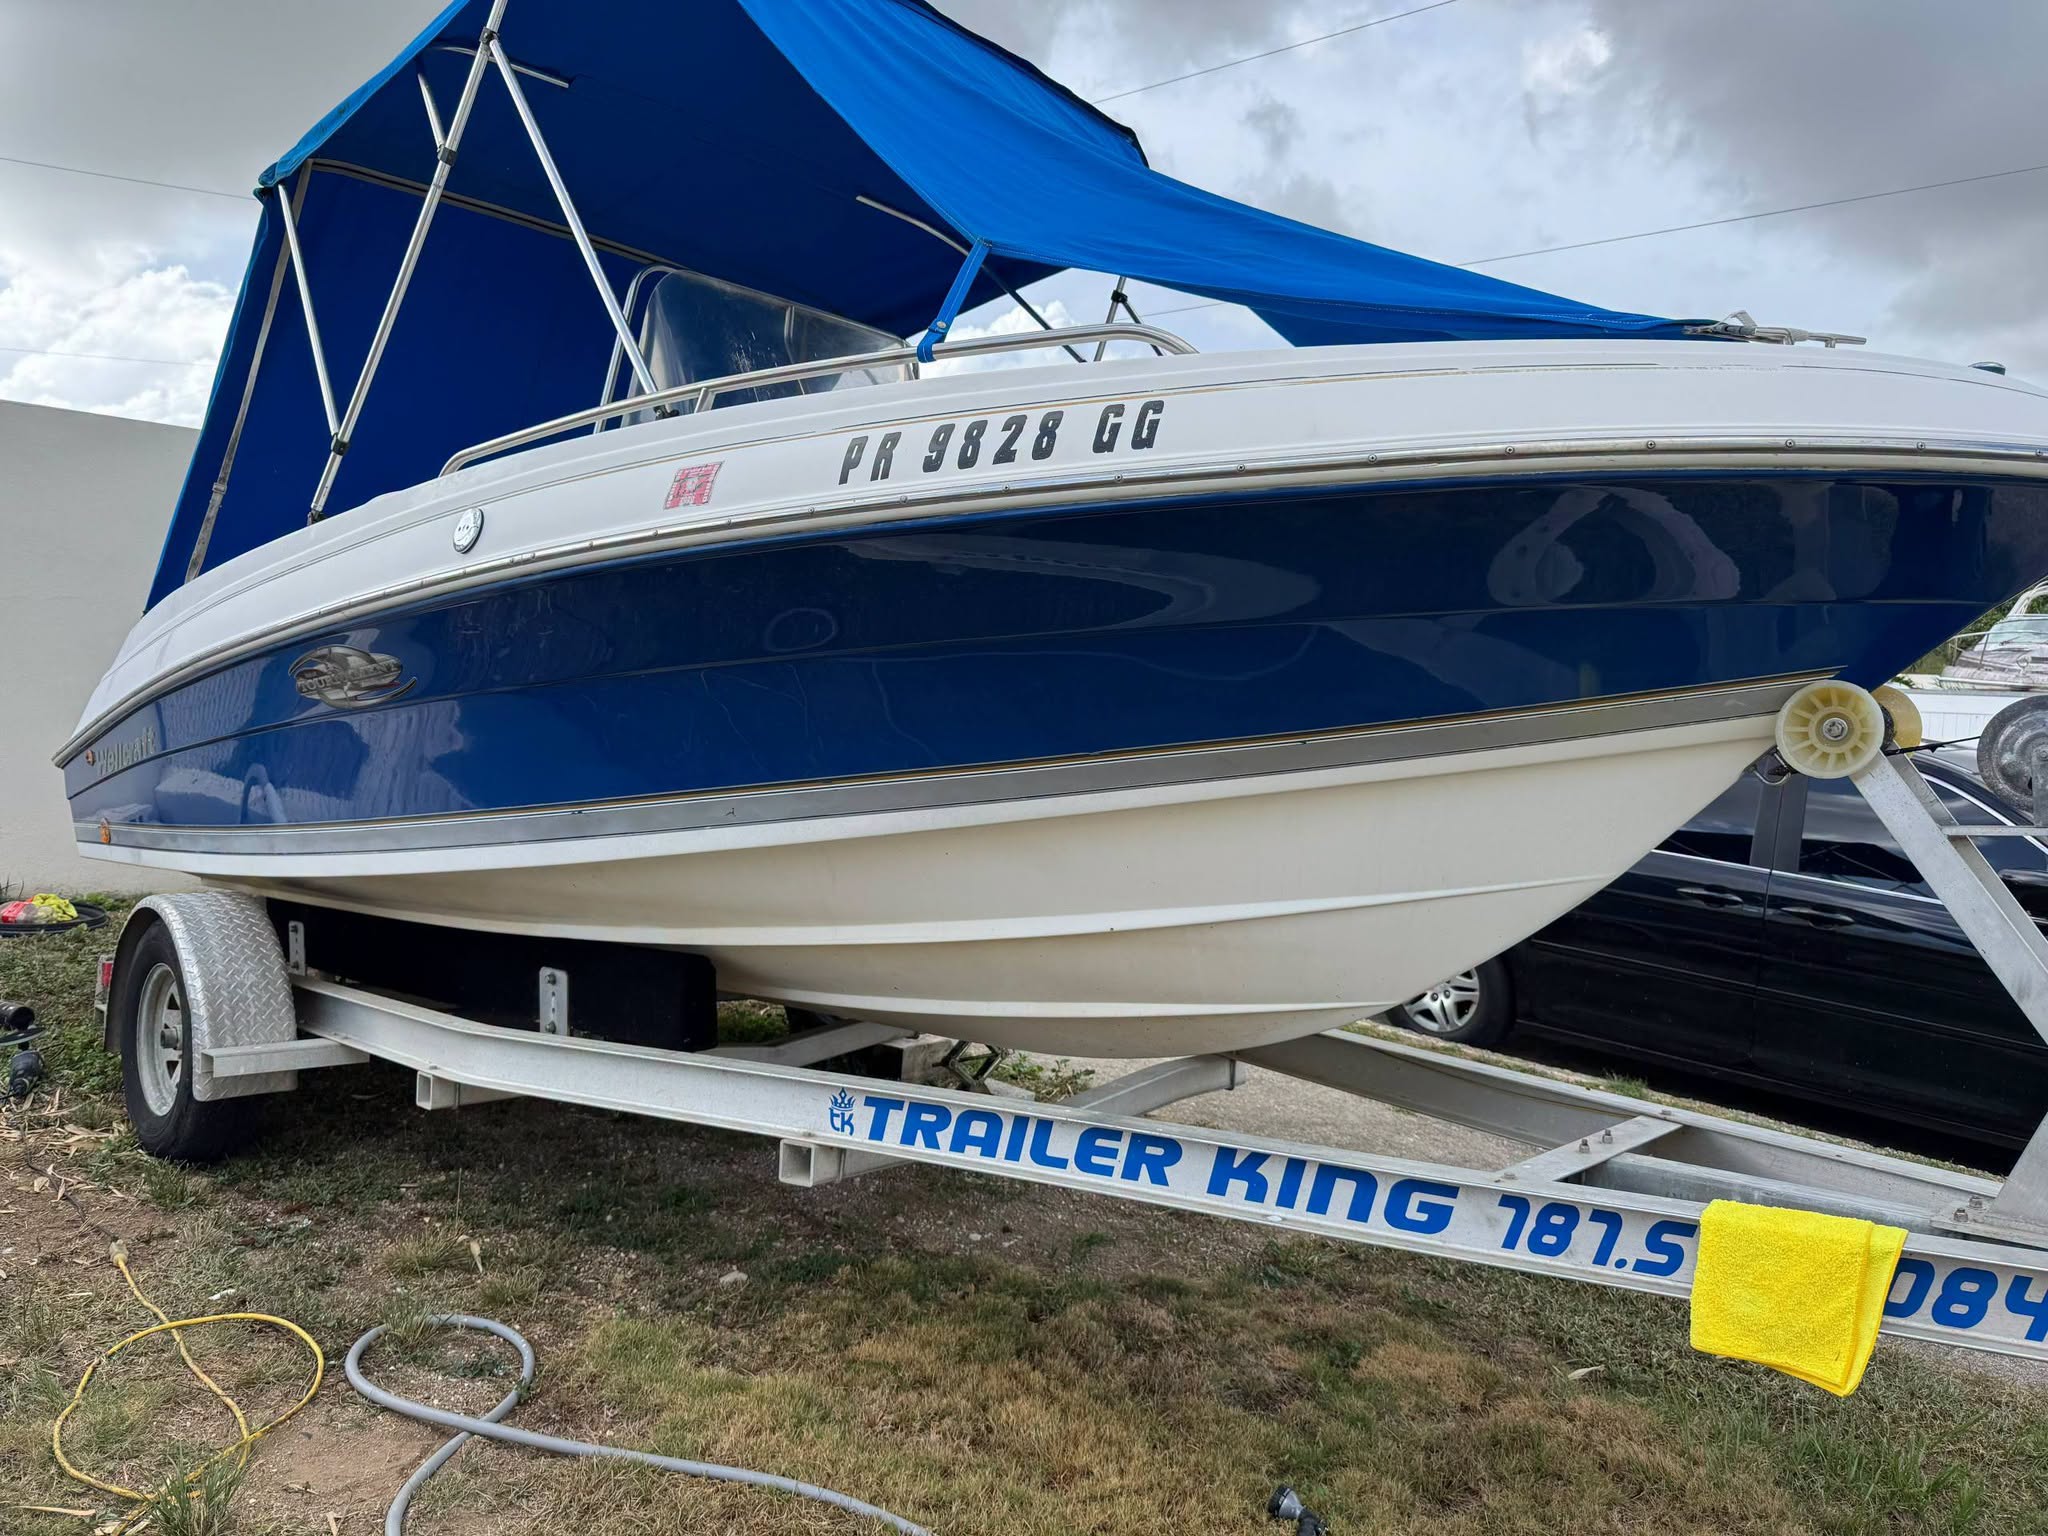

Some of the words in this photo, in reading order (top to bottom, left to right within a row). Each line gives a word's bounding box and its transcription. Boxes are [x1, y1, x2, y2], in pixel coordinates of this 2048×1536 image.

[838, 431, 902, 485] PR
[923, 410, 1064, 473] 9828
[1092, 400, 1165, 454] GG
[864, 1096, 1182, 1187] TRAILER
[1206, 1147, 1459, 1234] KING
